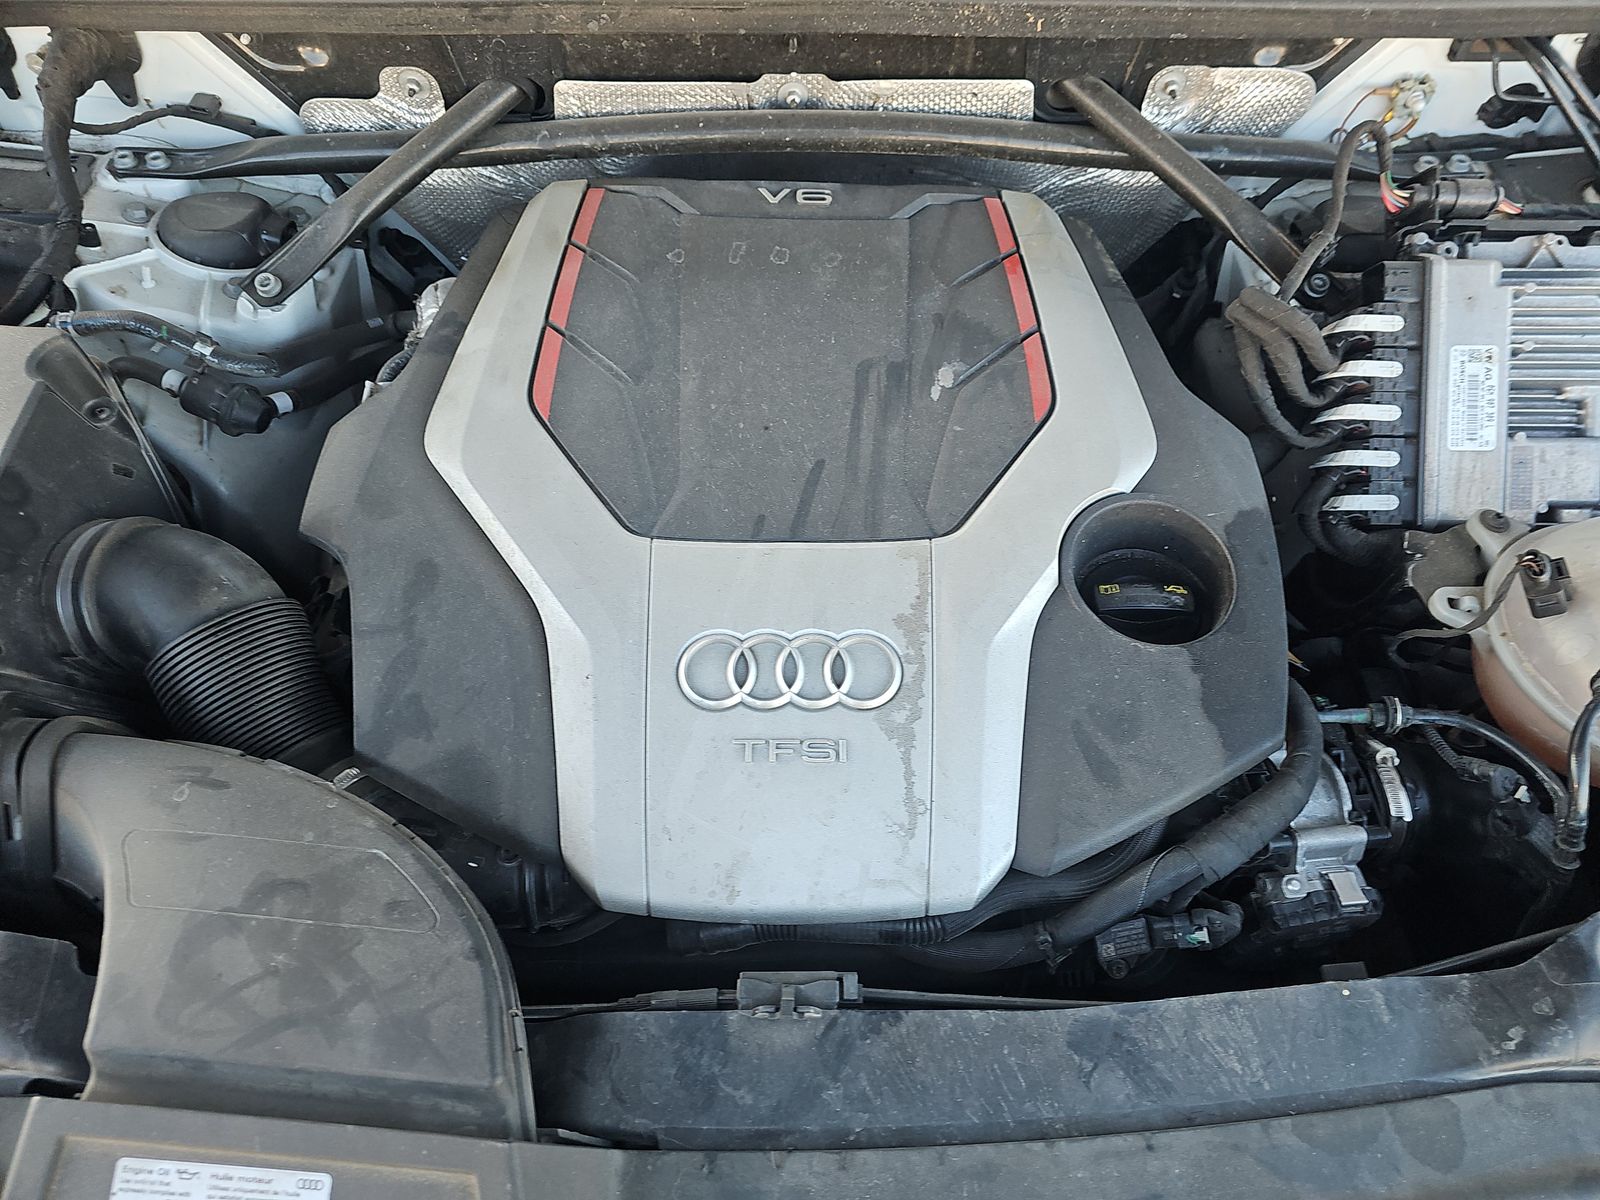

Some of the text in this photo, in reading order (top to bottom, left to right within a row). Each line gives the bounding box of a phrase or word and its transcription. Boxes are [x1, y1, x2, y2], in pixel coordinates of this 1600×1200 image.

[757, 187, 833, 206] V6
[1485, 347, 1493, 364] VW
[732, 738, 848, 763] TFSI
[121, 1165, 153, 1176] Engine
[238, 1176, 274, 1185] moteur
